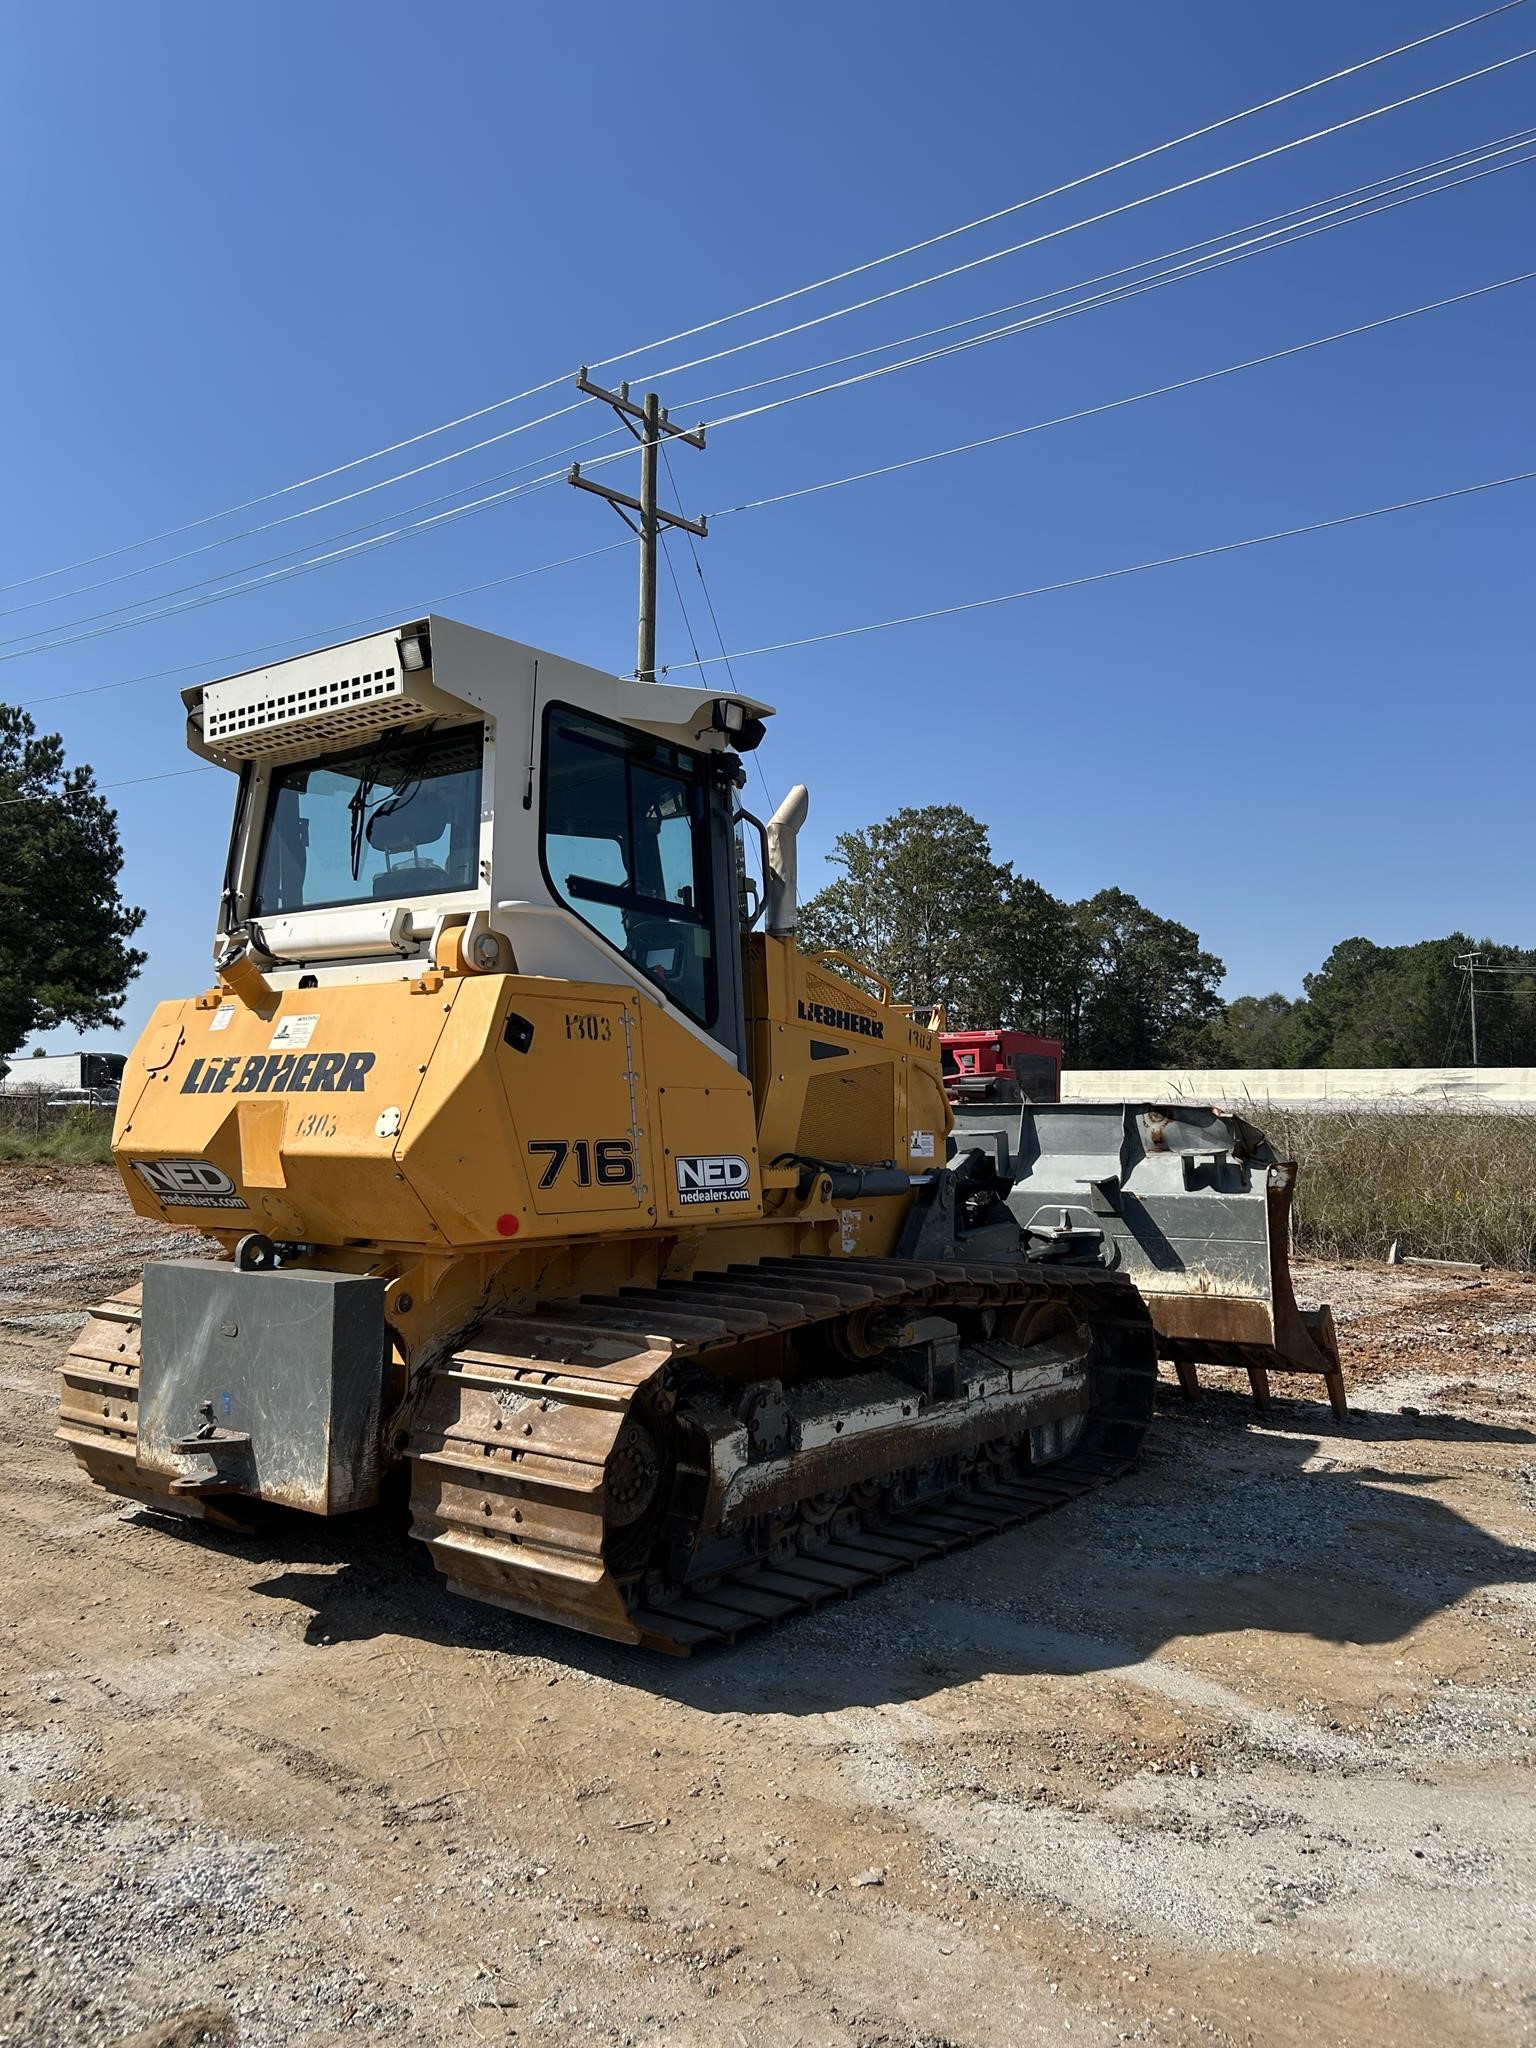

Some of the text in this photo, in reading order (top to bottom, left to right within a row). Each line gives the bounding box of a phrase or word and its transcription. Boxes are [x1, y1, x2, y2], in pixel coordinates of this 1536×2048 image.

[564, 1014, 612, 1041] 1303
[798, 1000, 884, 1040] LIEBHERR
[908, 1028, 932, 1051] 1303
[180, 1052, 376, 1094] LIEBHERR
[295, 1113, 337, 1137] 1303
[134, 1161, 233, 1192] NED
[528, 1139, 635, 1189] 716
[678, 1158, 748, 1188] NED
[159, 1193, 248, 1208] nedealers.com
[680, 1189, 750, 1203] nedealers.com
